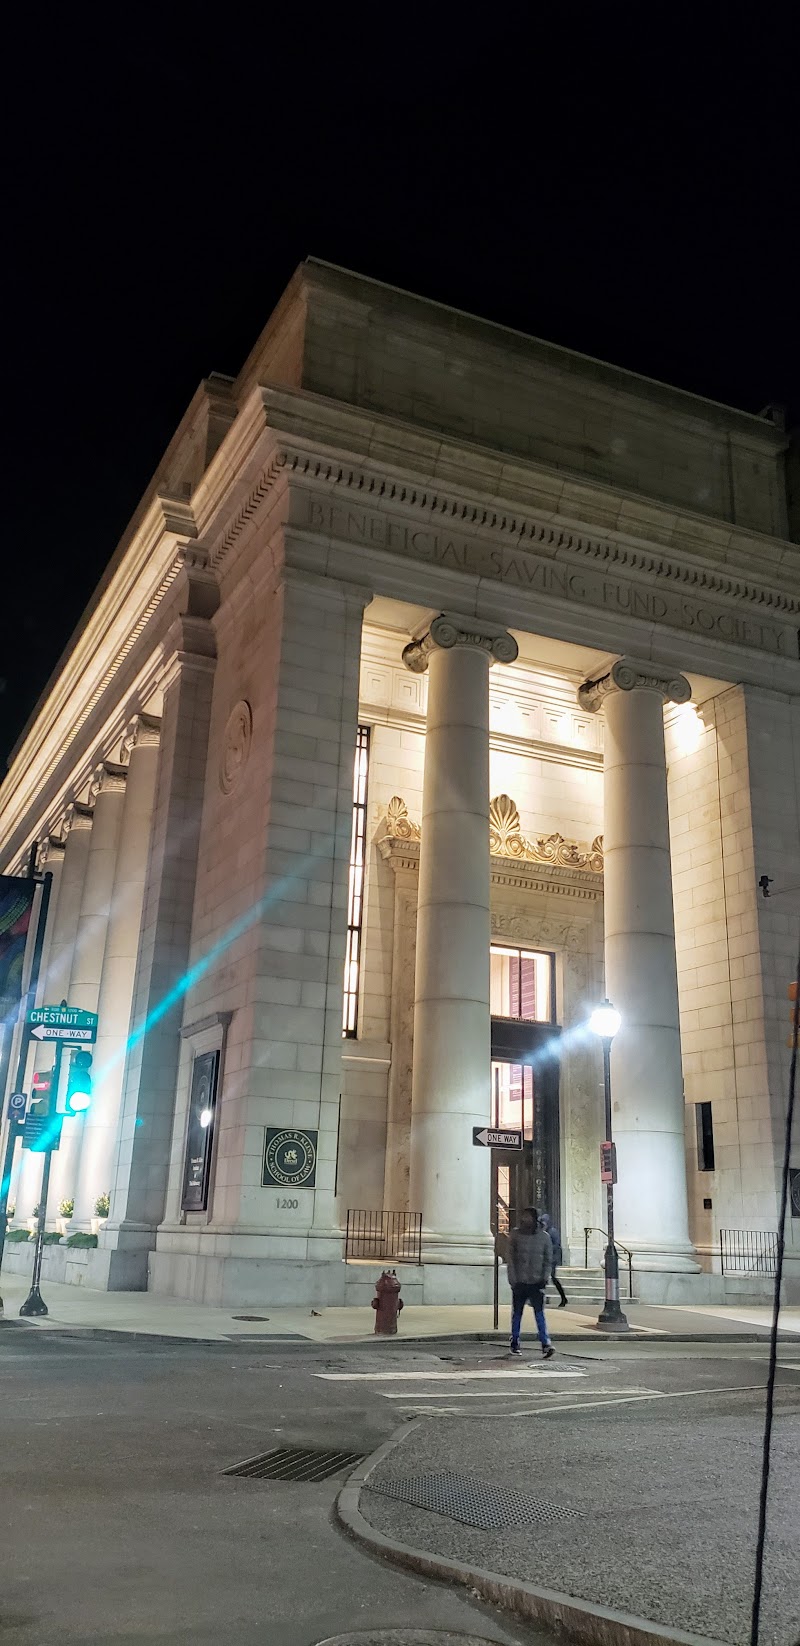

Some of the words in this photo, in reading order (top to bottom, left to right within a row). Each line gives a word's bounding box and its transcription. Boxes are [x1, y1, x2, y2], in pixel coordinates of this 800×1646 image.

[308, 501, 469, 567] BENEFICIAL
[489, 551, 586, 598] SAVING
[602, 582, 668, 617] FUND
[683, 604, 784, 650] SOCIETY
[30, 1011, 78, 1024] CHESTNUT
[86, 1017, 94, 1025] ST
[15, 1097, 22, 1105] P
[487, 1133, 502, 1142] ONE
[504, 1134, 517, 1143] WAY
[269, 1132, 292, 1156] THOMAS
[300, 1137, 313, 1159] KLINE
[269, 1161, 291, 1183] SCHOOL
[300, 1163, 311, 1178] LAW
[276, 1198, 299, 1209] 1200
